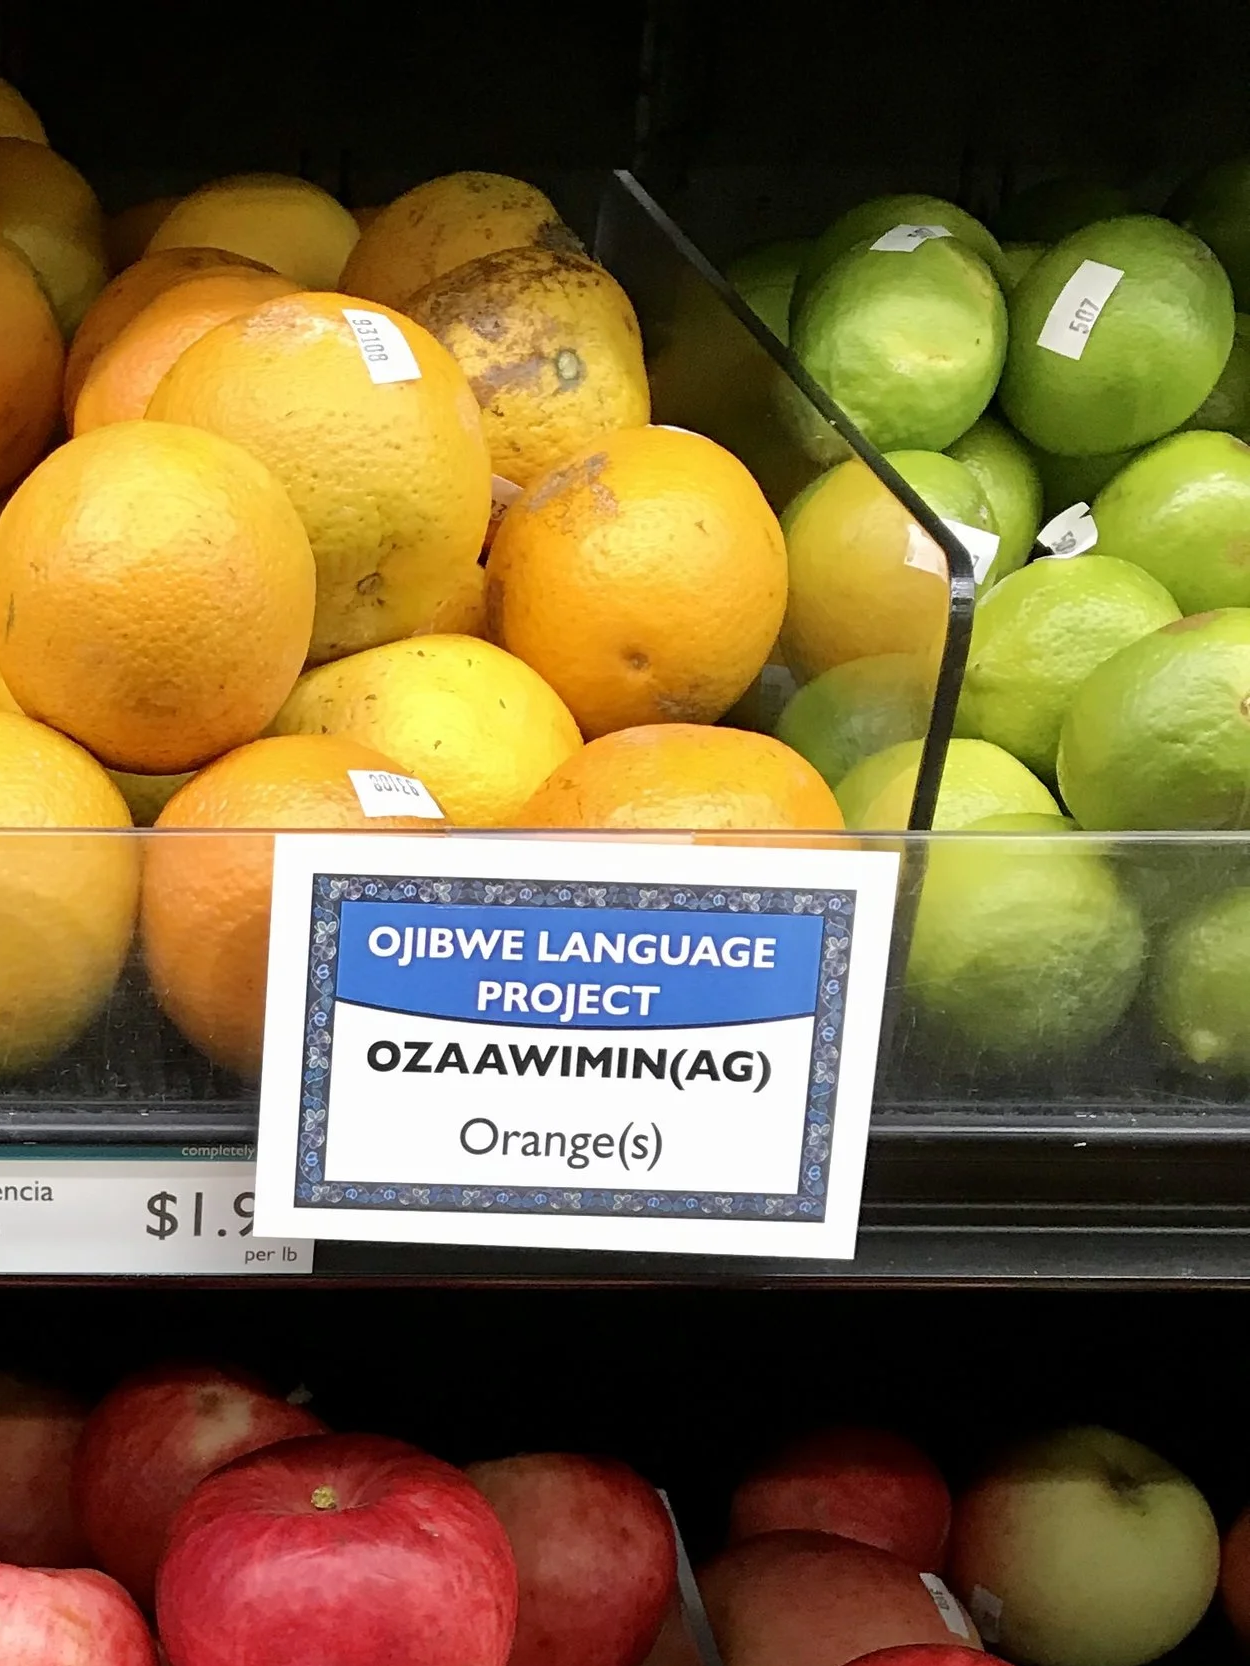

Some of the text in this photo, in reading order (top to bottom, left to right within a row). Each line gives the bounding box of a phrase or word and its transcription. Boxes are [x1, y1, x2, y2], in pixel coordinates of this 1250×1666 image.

[1068, 297, 1100, 335] 507
[352, 319, 389, 362] 93108
[368, 774, 420, 797] 93108
[368, 926, 777, 969] OJIBWE LANGUAGE
[477, 981, 660, 1023] PROJECT
[367, 1040, 771, 1093] OZAAWIMIN(AG)
[181, 1145, 256, 1160] completely
[459, 1117, 662, 1171] Orange(s)
[146, 1191, 256, 1240] $1.9
[245, 1247, 298, 1264] per lb
